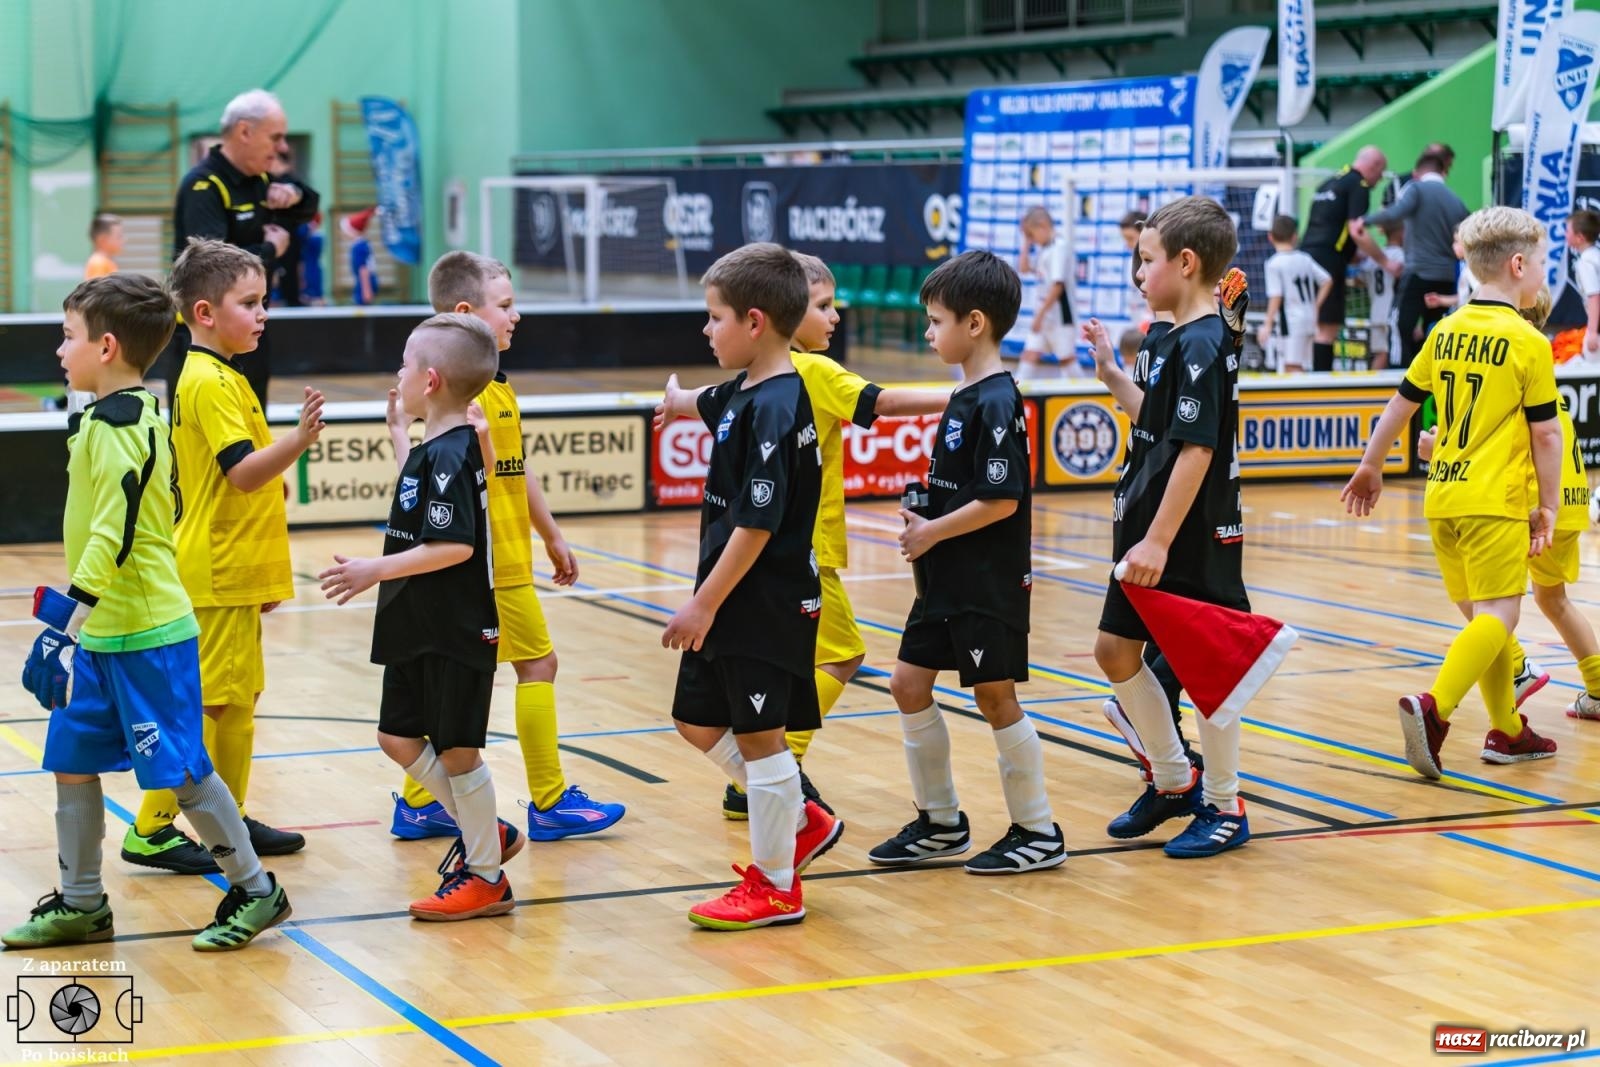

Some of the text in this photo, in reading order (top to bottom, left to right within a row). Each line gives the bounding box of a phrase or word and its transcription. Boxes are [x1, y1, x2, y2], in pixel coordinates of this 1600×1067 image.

[1556, 68, 1588, 87] UNIA
[1534, 152, 1563, 221] NIA
[788, 195, 885, 242] RACIBÓRZ
[1293, 275, 1312, 304] 11
[1373, 269, 1384, 296] 8
[1434, 332, 1510, 367] RAFAKO
[498, 410, 513, 419] JAKO
[1440, 370, 1483, 450] 11
[521, 424, 634, 455] TAVEBNÍ
[137, 734, 157, 751] UNIA
